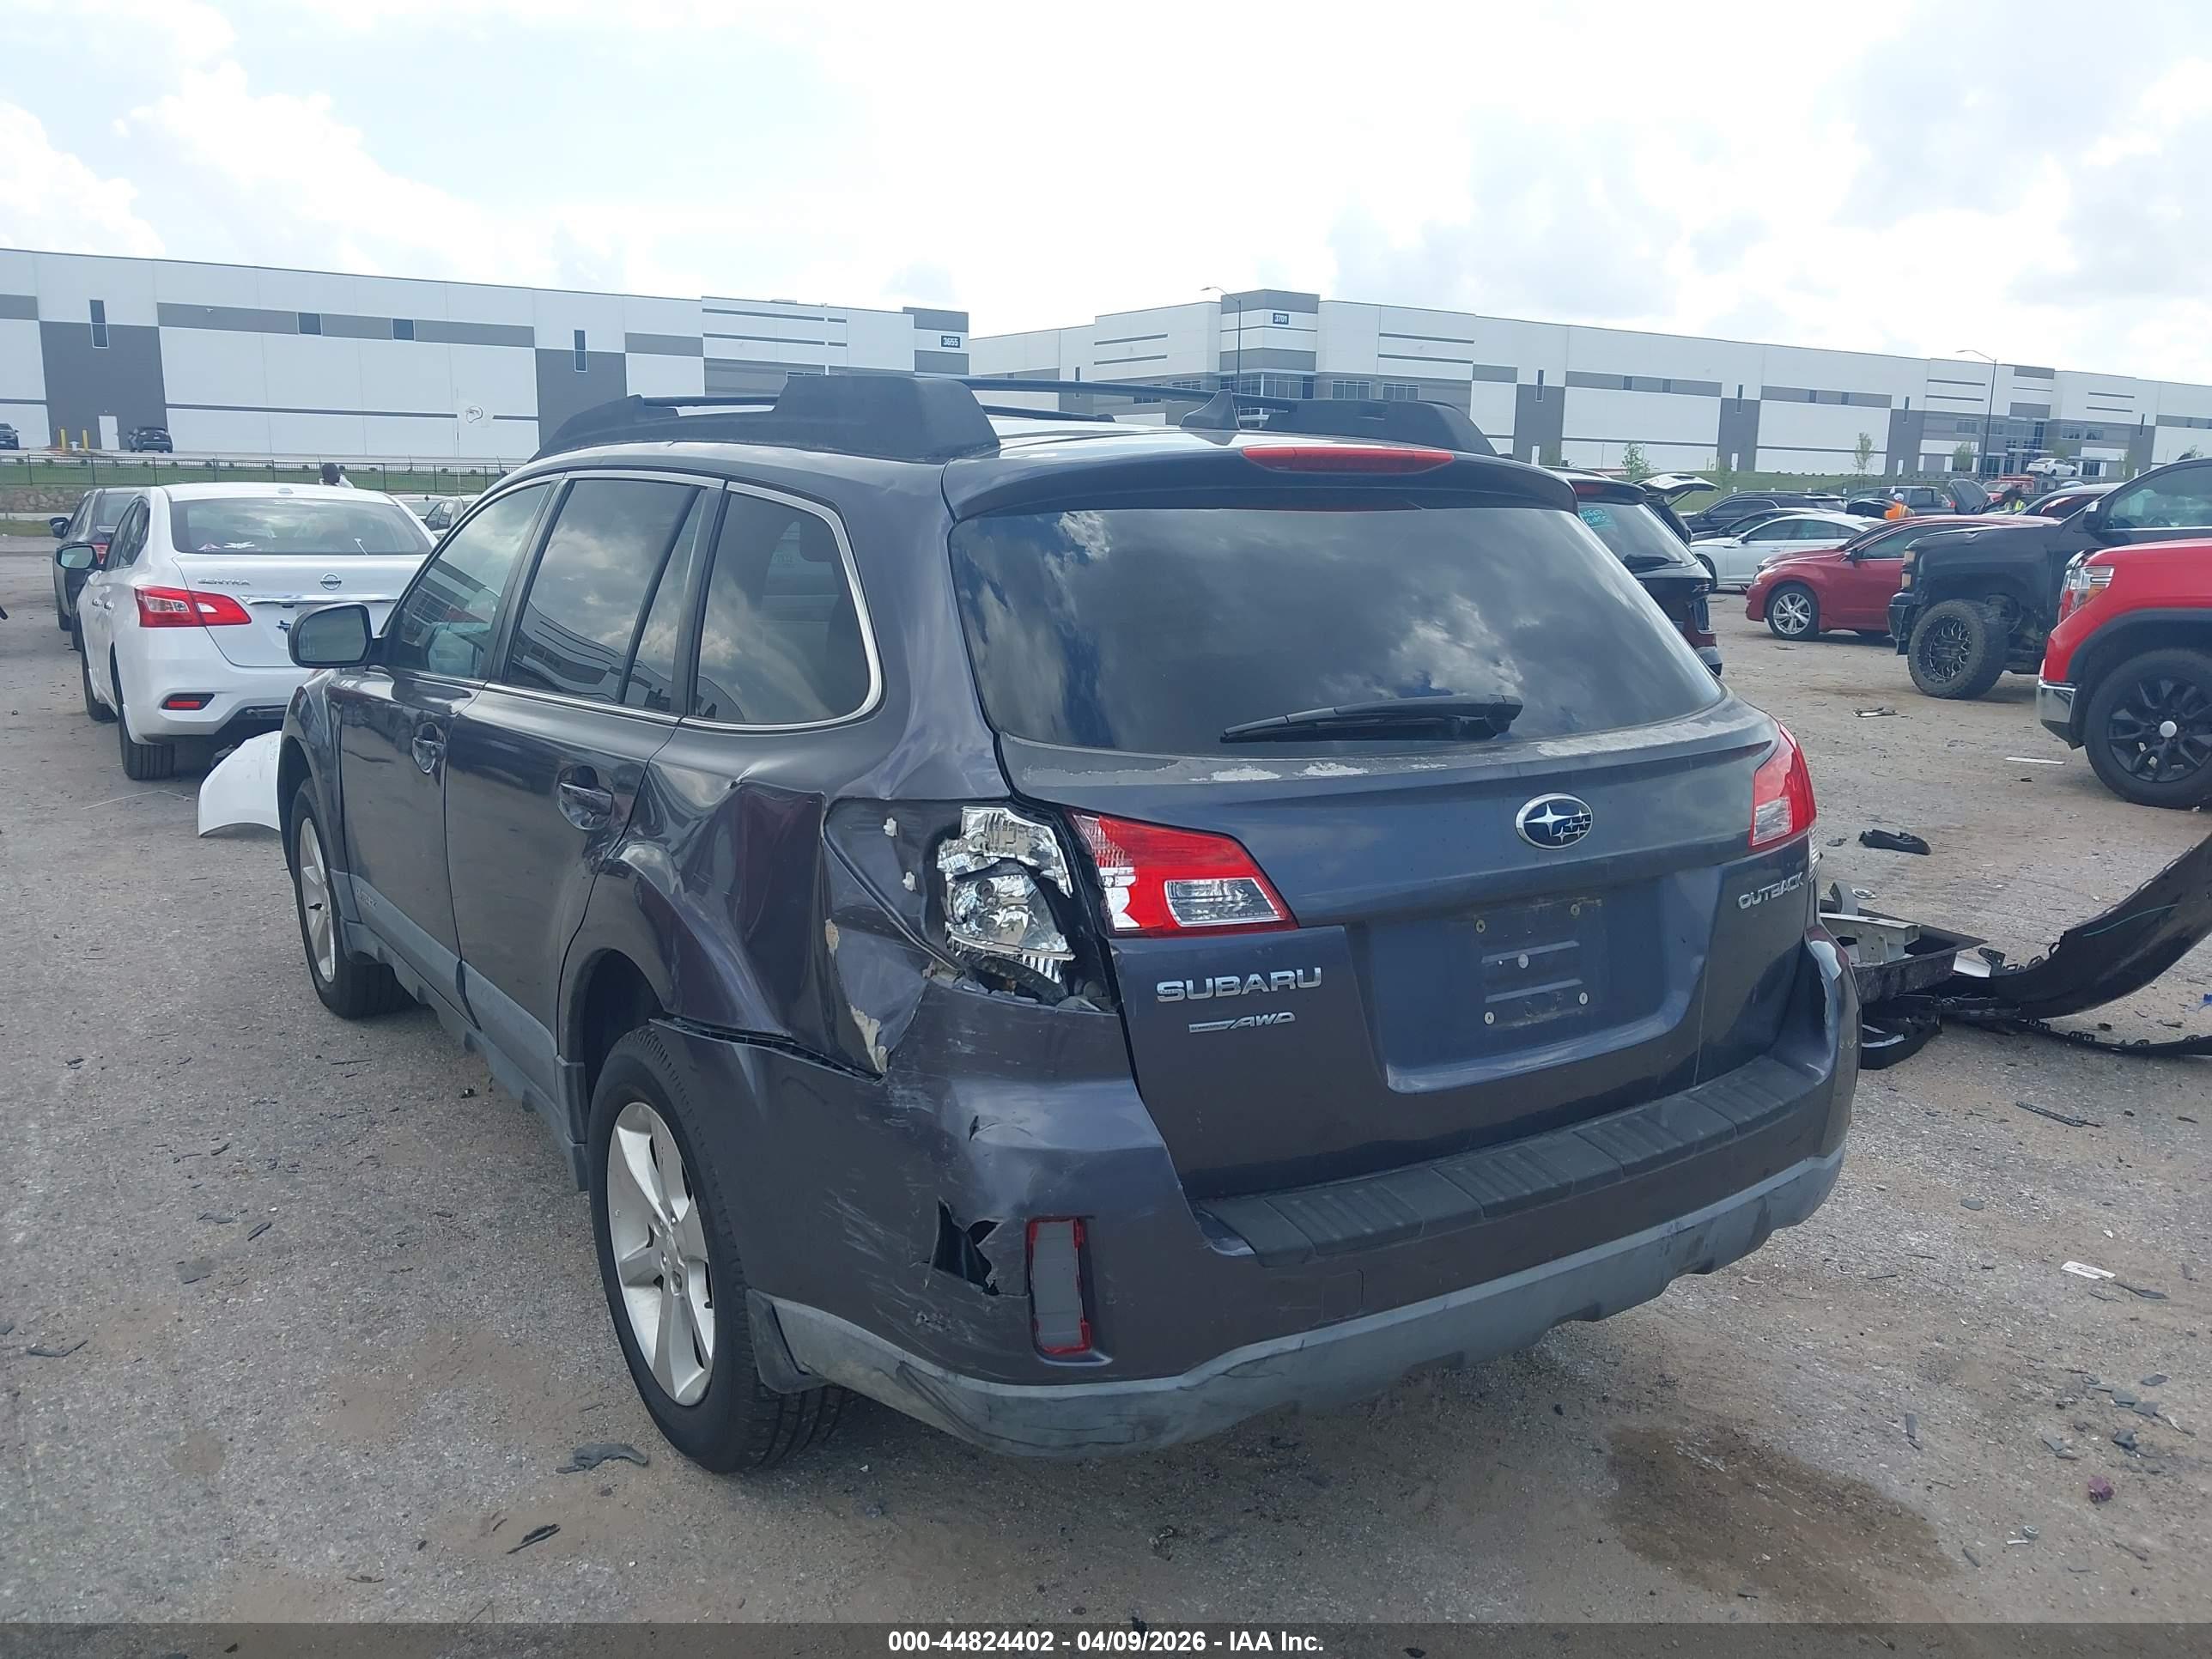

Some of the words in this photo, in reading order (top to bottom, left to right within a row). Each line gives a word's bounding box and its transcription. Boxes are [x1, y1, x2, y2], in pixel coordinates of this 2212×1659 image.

[1273, 314, 1288, 324] 3701
[943, 337, 959, 347] 3655
[197, 577, 251, 586] SENTRA
[1738, 872, 1804, 909] OUTBACK
[1157, 967, 1322, 1003] SUBARU
[1230, 1012, 1296, 1030] AWD
